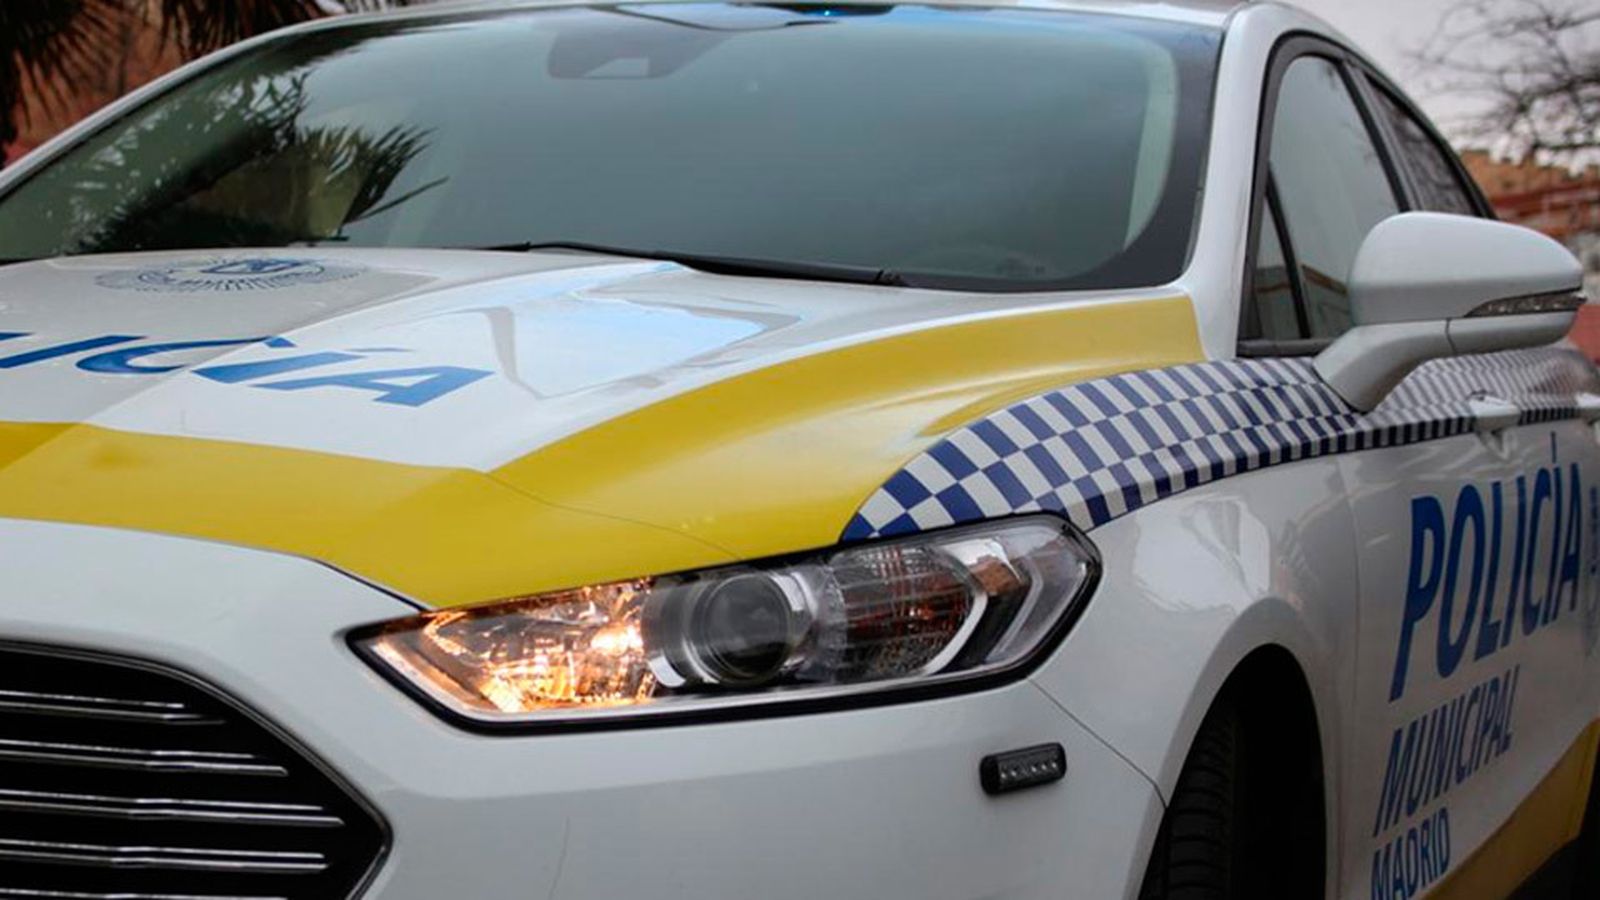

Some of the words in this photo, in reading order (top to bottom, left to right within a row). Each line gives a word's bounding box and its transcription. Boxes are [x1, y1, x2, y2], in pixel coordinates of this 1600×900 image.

[0, 332, 496, 407] ICÍA
[1389, 431, 1581, 703] POLICÍA
[1372, 664, 1520, 837] MUNICIPAL
[1371, 806, 1450, 900] MADRID
